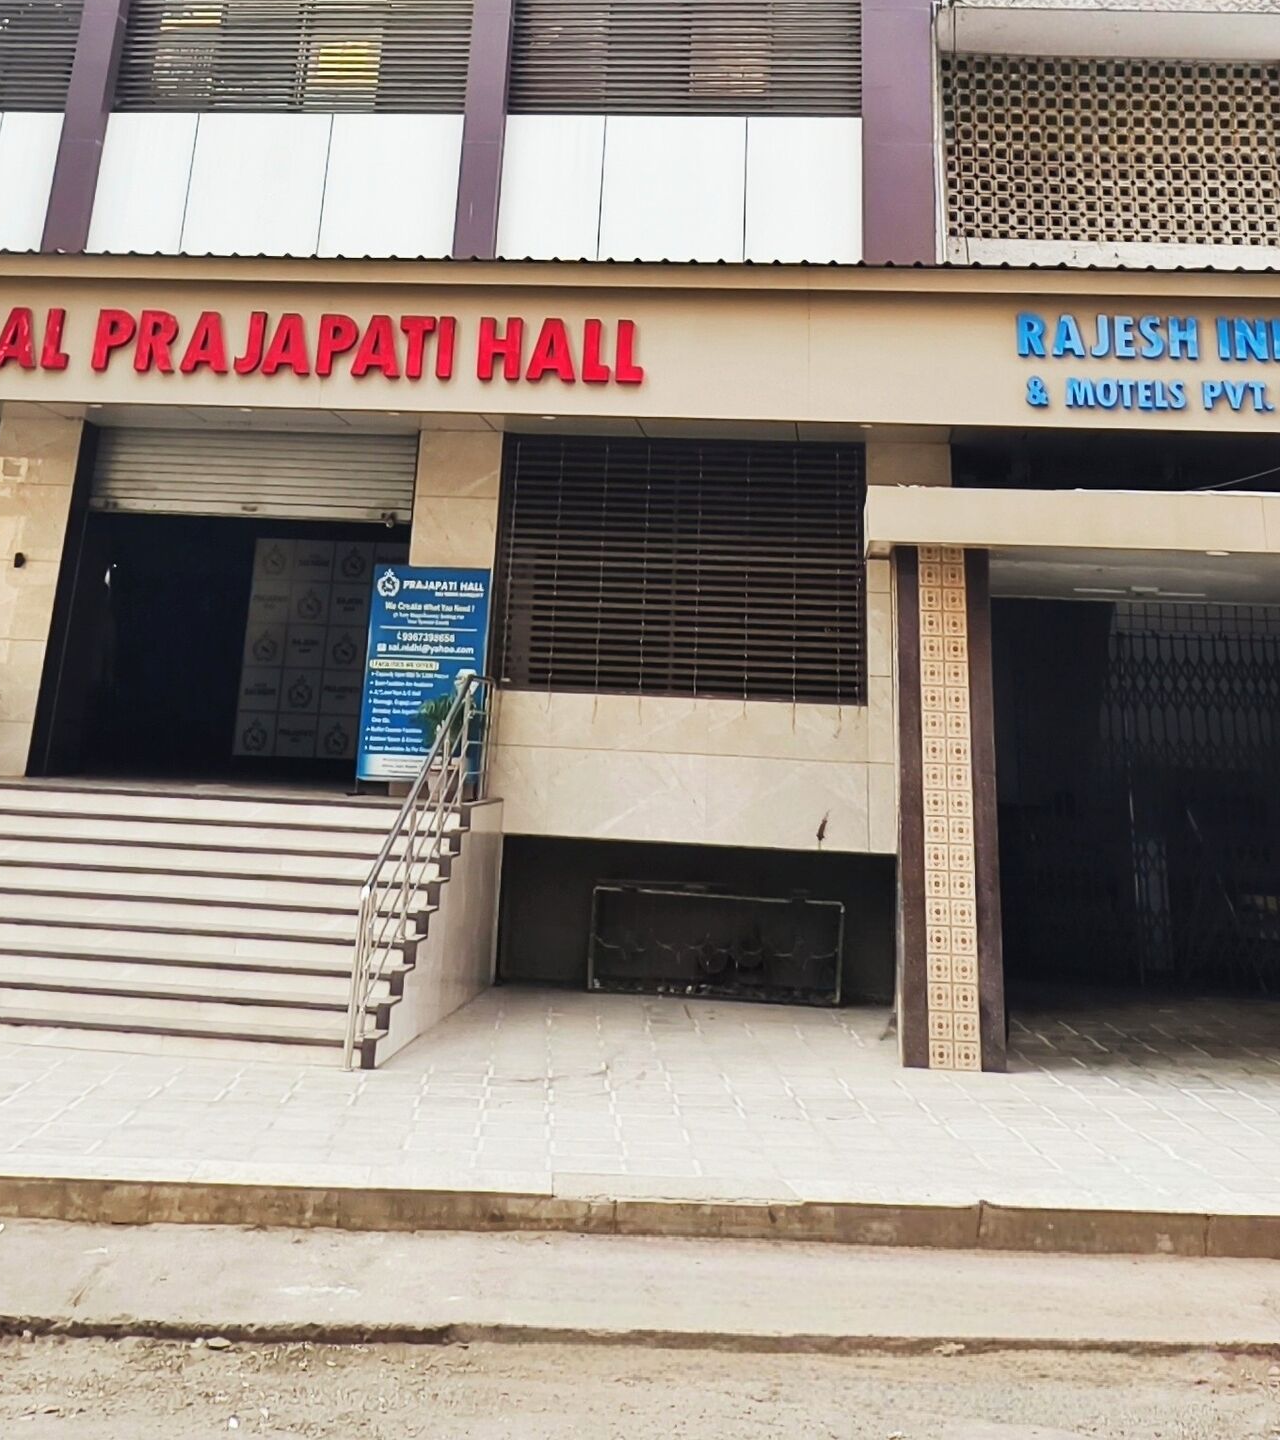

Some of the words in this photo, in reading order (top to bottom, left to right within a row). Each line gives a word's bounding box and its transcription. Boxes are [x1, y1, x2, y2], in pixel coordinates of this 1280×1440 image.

[91, 309, 457, 380] PRAJAPATI
[477, 316, 645, 384] HALL
[1016, 312, 1199, 360] RAJESH
[1025, 376, 1050, 408] &
[1065, 377, 1185, 411] MOTELS
[1202, 380, 1274, 412] PVT.
[403, 580, 458, 591] PRAJAPATI
[460, 581, 485, 592] HALL
